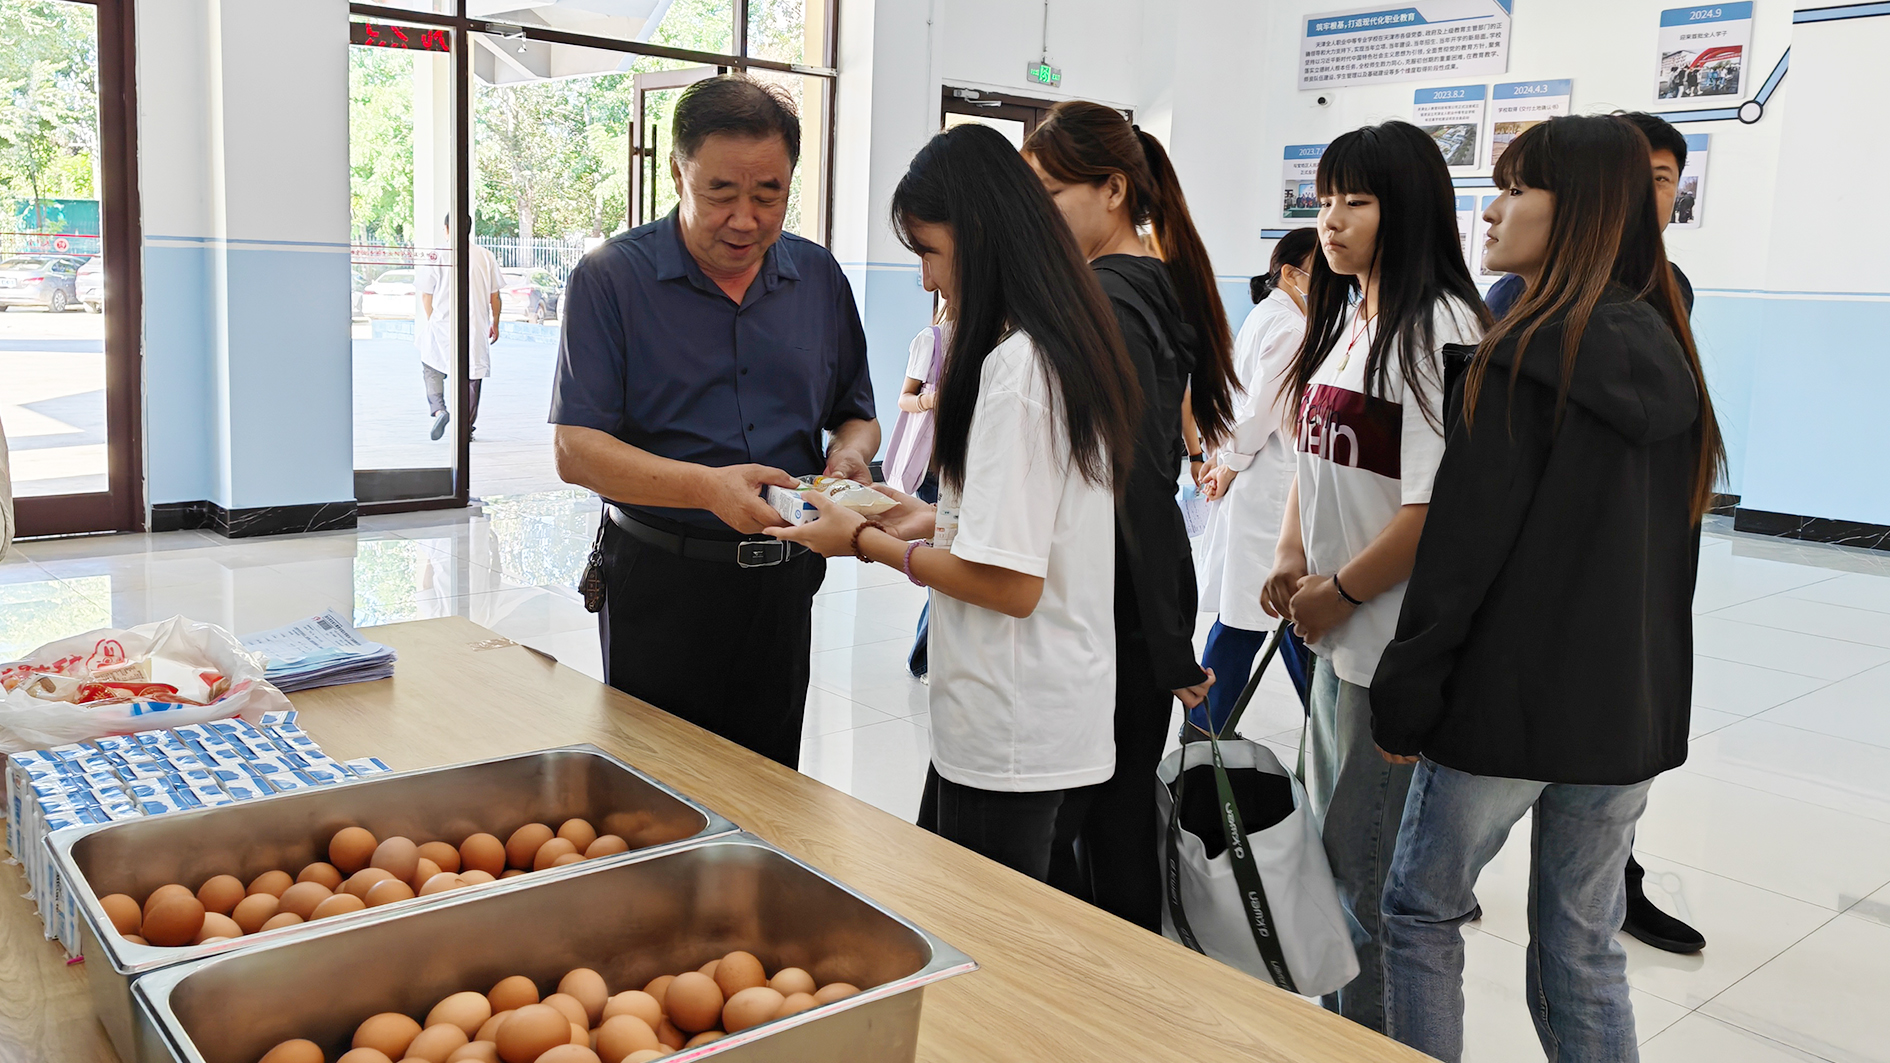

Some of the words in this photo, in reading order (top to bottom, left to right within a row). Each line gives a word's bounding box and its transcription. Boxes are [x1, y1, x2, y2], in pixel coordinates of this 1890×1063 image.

[1689, 8, 1722, 20] 2024.9
[1433, 90, 1465, 100] 2023.8.2
[1513, 84, 1548, 95] 2024.4.3
